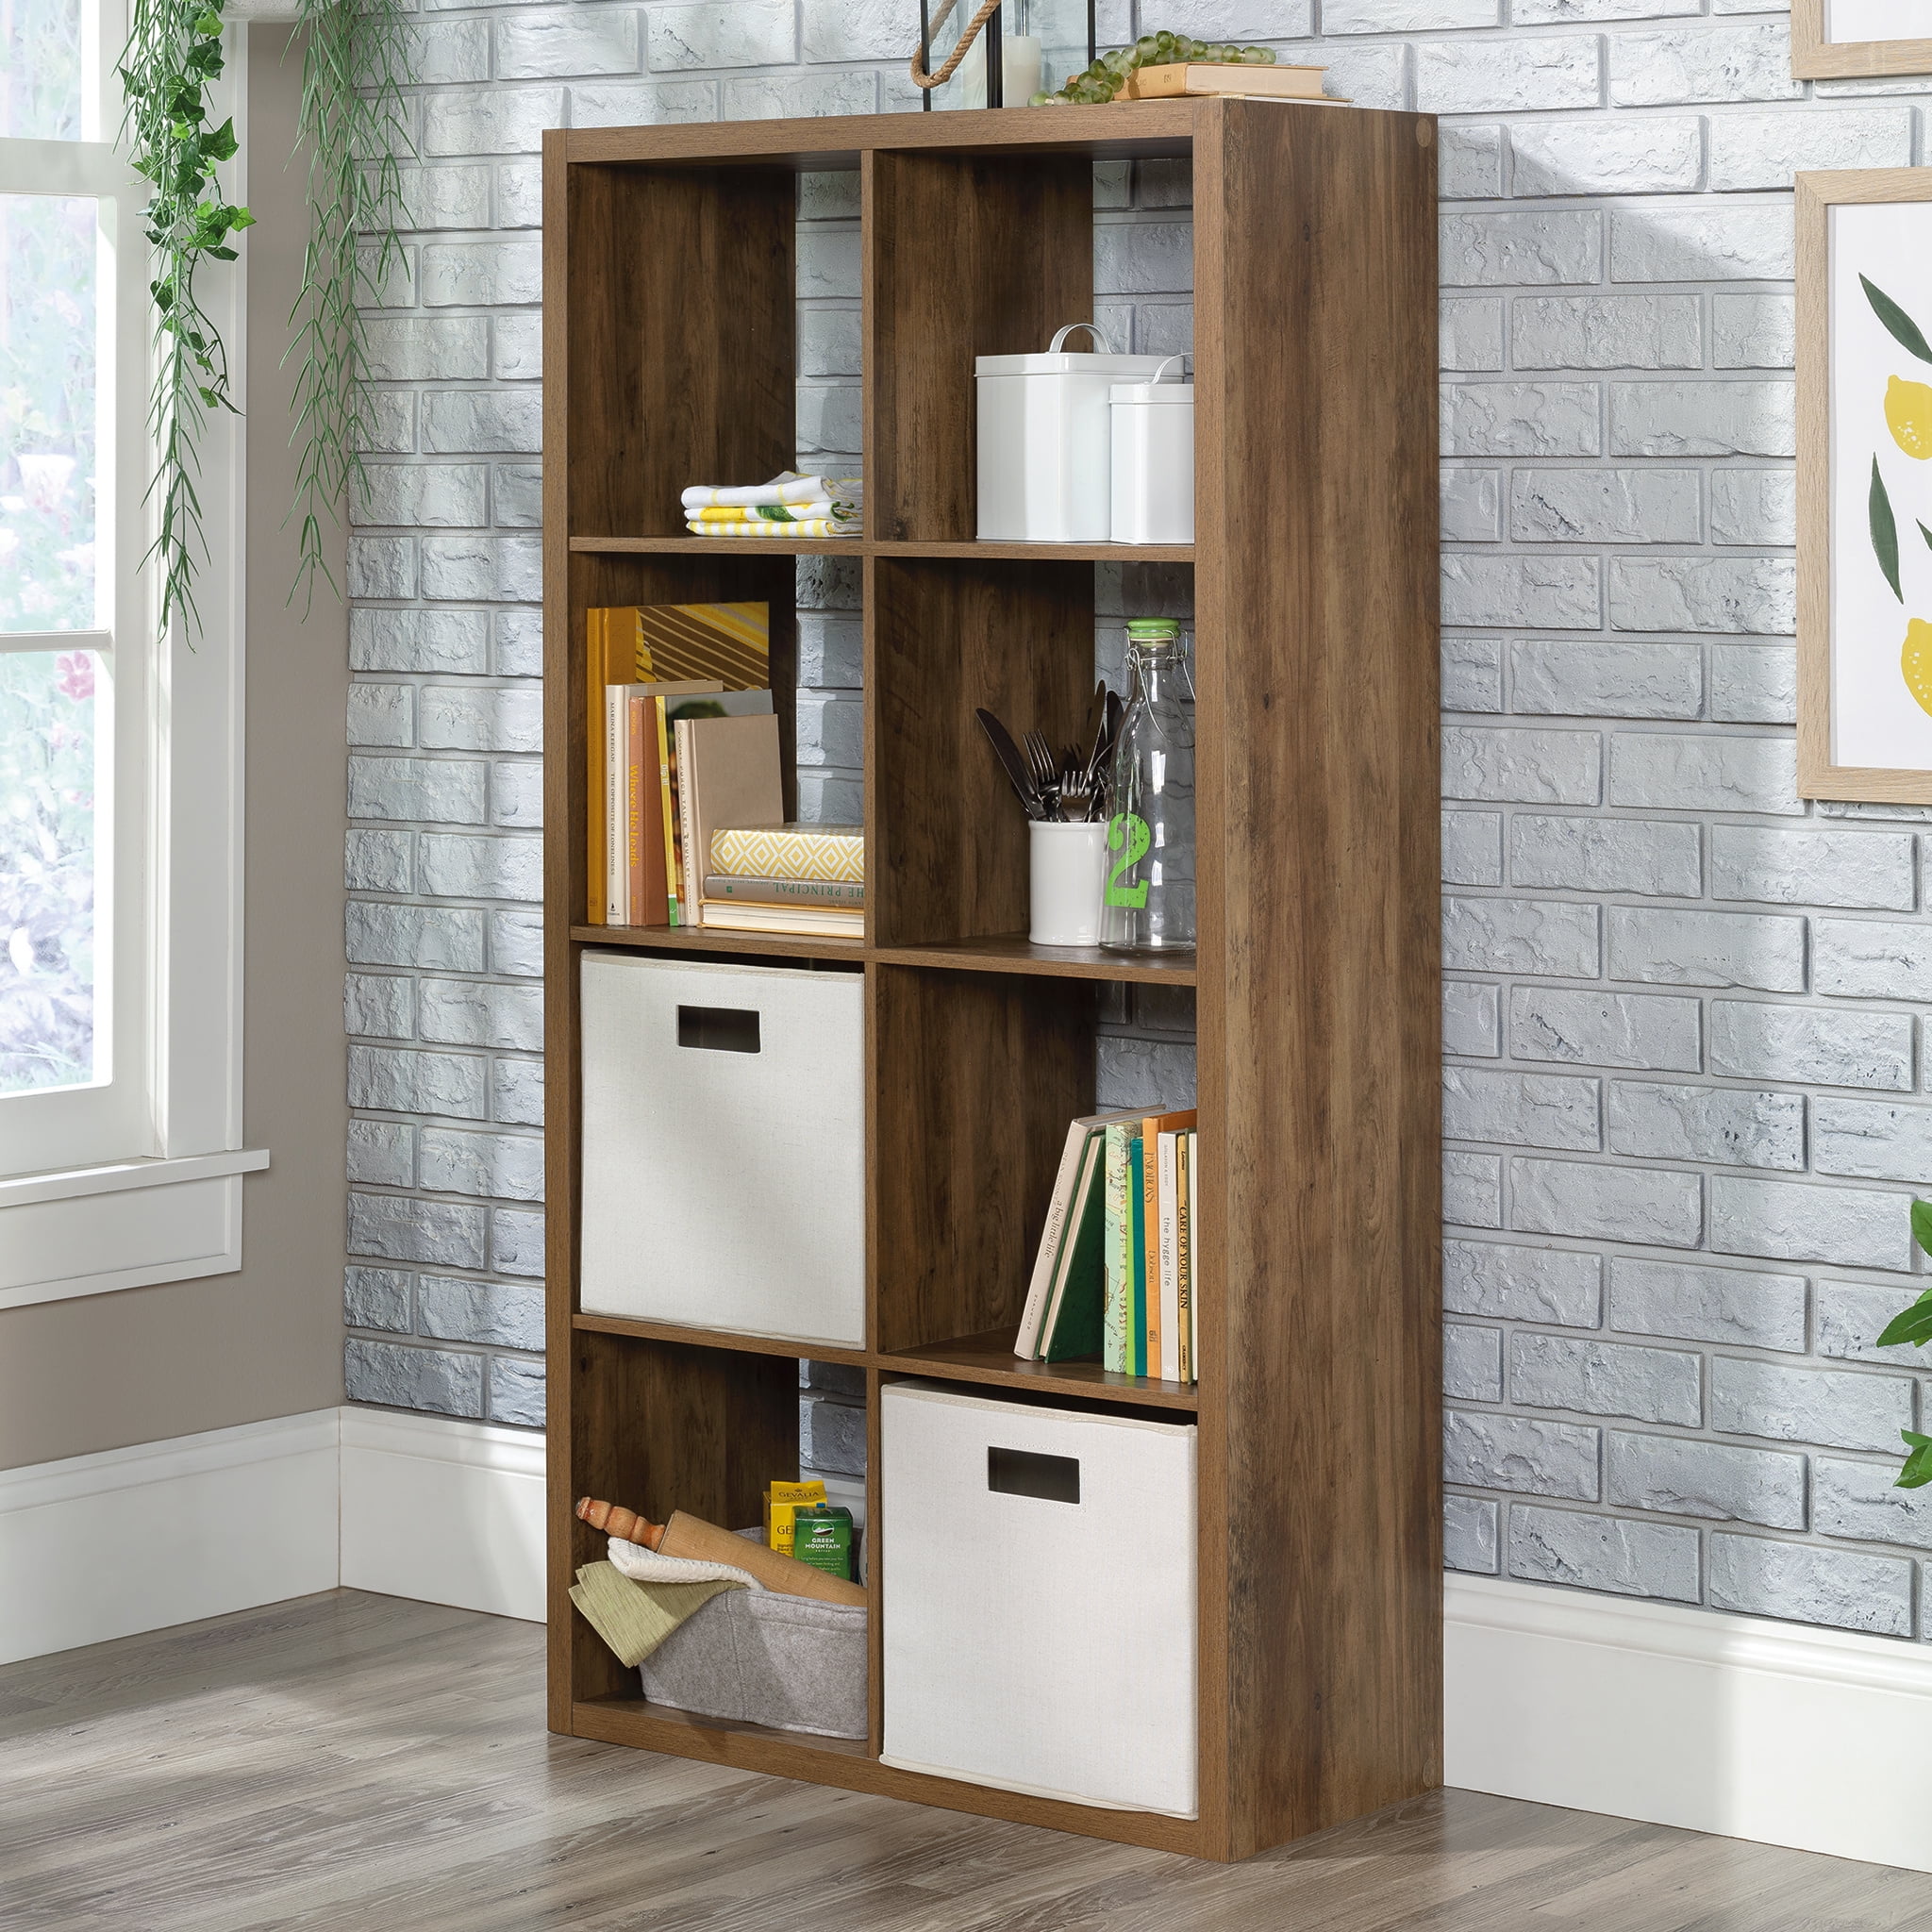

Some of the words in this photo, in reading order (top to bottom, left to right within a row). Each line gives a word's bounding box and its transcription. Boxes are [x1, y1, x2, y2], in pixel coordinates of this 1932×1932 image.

[629, 764, 640, 808] Where
[610, 823, 616, 832] OF
[629, 810, 640, 829] He
[629, 831, 640, 867] Leads
[1105, 811, 1152, 909] 2
[773, 883, 841, 897] PRINCIPAL
[847, 887, 864, 898] HE
[1144, 1151, 1155, 1204] EMOTIONS
[1051, 1208, 1063, 1222] big
[1179, 1207, 1188, 1234] CARE
[1048, 1223, 1060, 1243] little
[1163, 1217, 1172, 1234] the
[1043, 1243, 1056, 1258] life
[1162, 1237, 1172, 1267] hygge
[1179, 1236, 1188, 1250] OF
[1179, 1252, 1188, 1281] YOUR
[1163, 1270, 1173, 1287] life
[1179, 1283, 1188, 1309] SKIN
